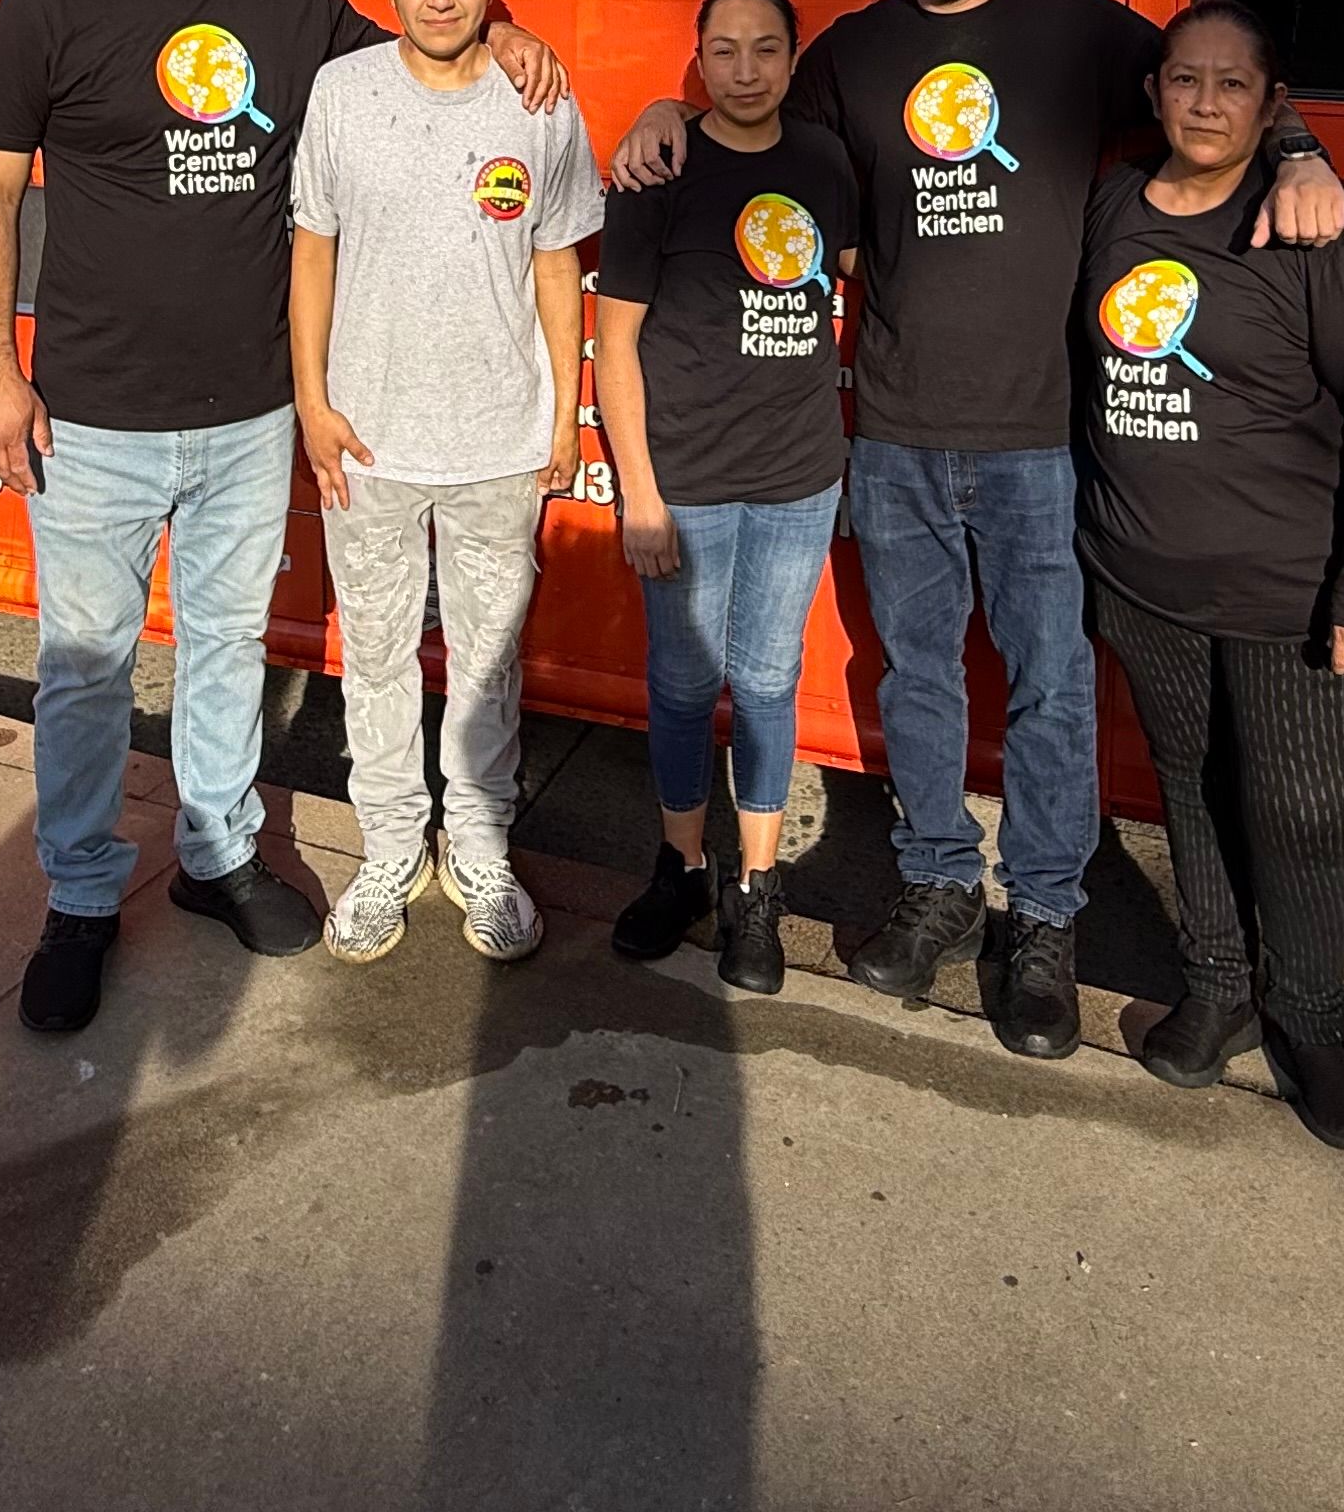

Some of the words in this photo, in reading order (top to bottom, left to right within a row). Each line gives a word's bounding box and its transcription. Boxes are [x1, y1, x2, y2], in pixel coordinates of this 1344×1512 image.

[164, 124, 236, 152] World
[168, 145, 257, 173] Central
[169, 171, 256, 195] Kitchen
[911, 163, 977, 189] World
[916, 185, 998, 213] Central
[917, 211, 1004, 237] Kitchen
[739, 289, 807, 311] World
[742, 309, 818, 334] Central
[1101, 355, 1168, 386] World
[1106, 383, 1191, 413] Central
[1105, 408, 1199, 441] Kitchen
